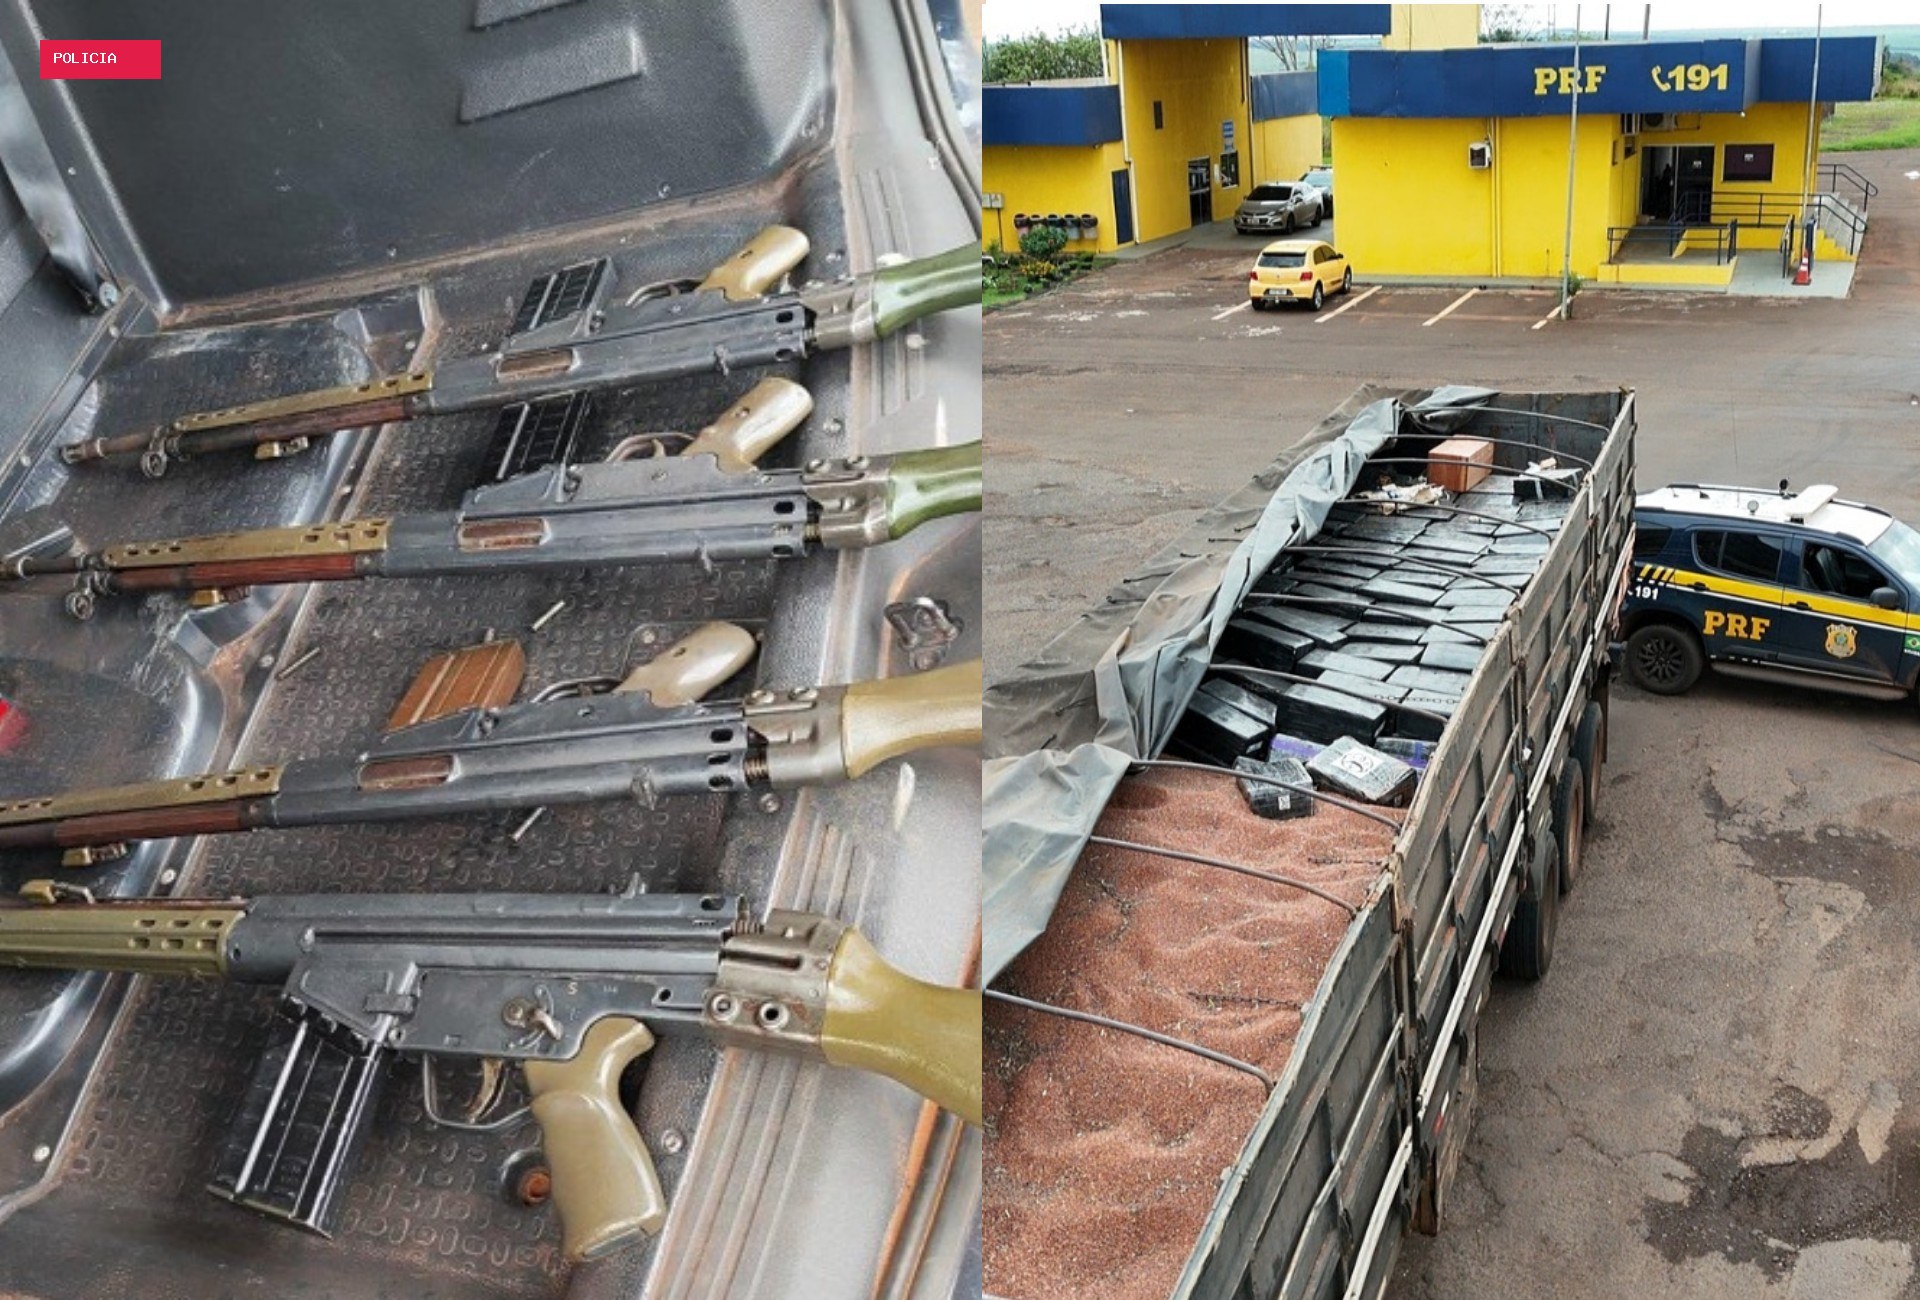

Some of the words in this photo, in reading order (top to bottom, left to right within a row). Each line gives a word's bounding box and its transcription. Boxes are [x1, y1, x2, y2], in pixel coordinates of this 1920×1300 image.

[1534, 65, 1607, 95] PRF
[1667, 64, 1728, 91] 191
[1635, 585, 1659, 600] 191
[1703, 610, 1770, 641] PRF
